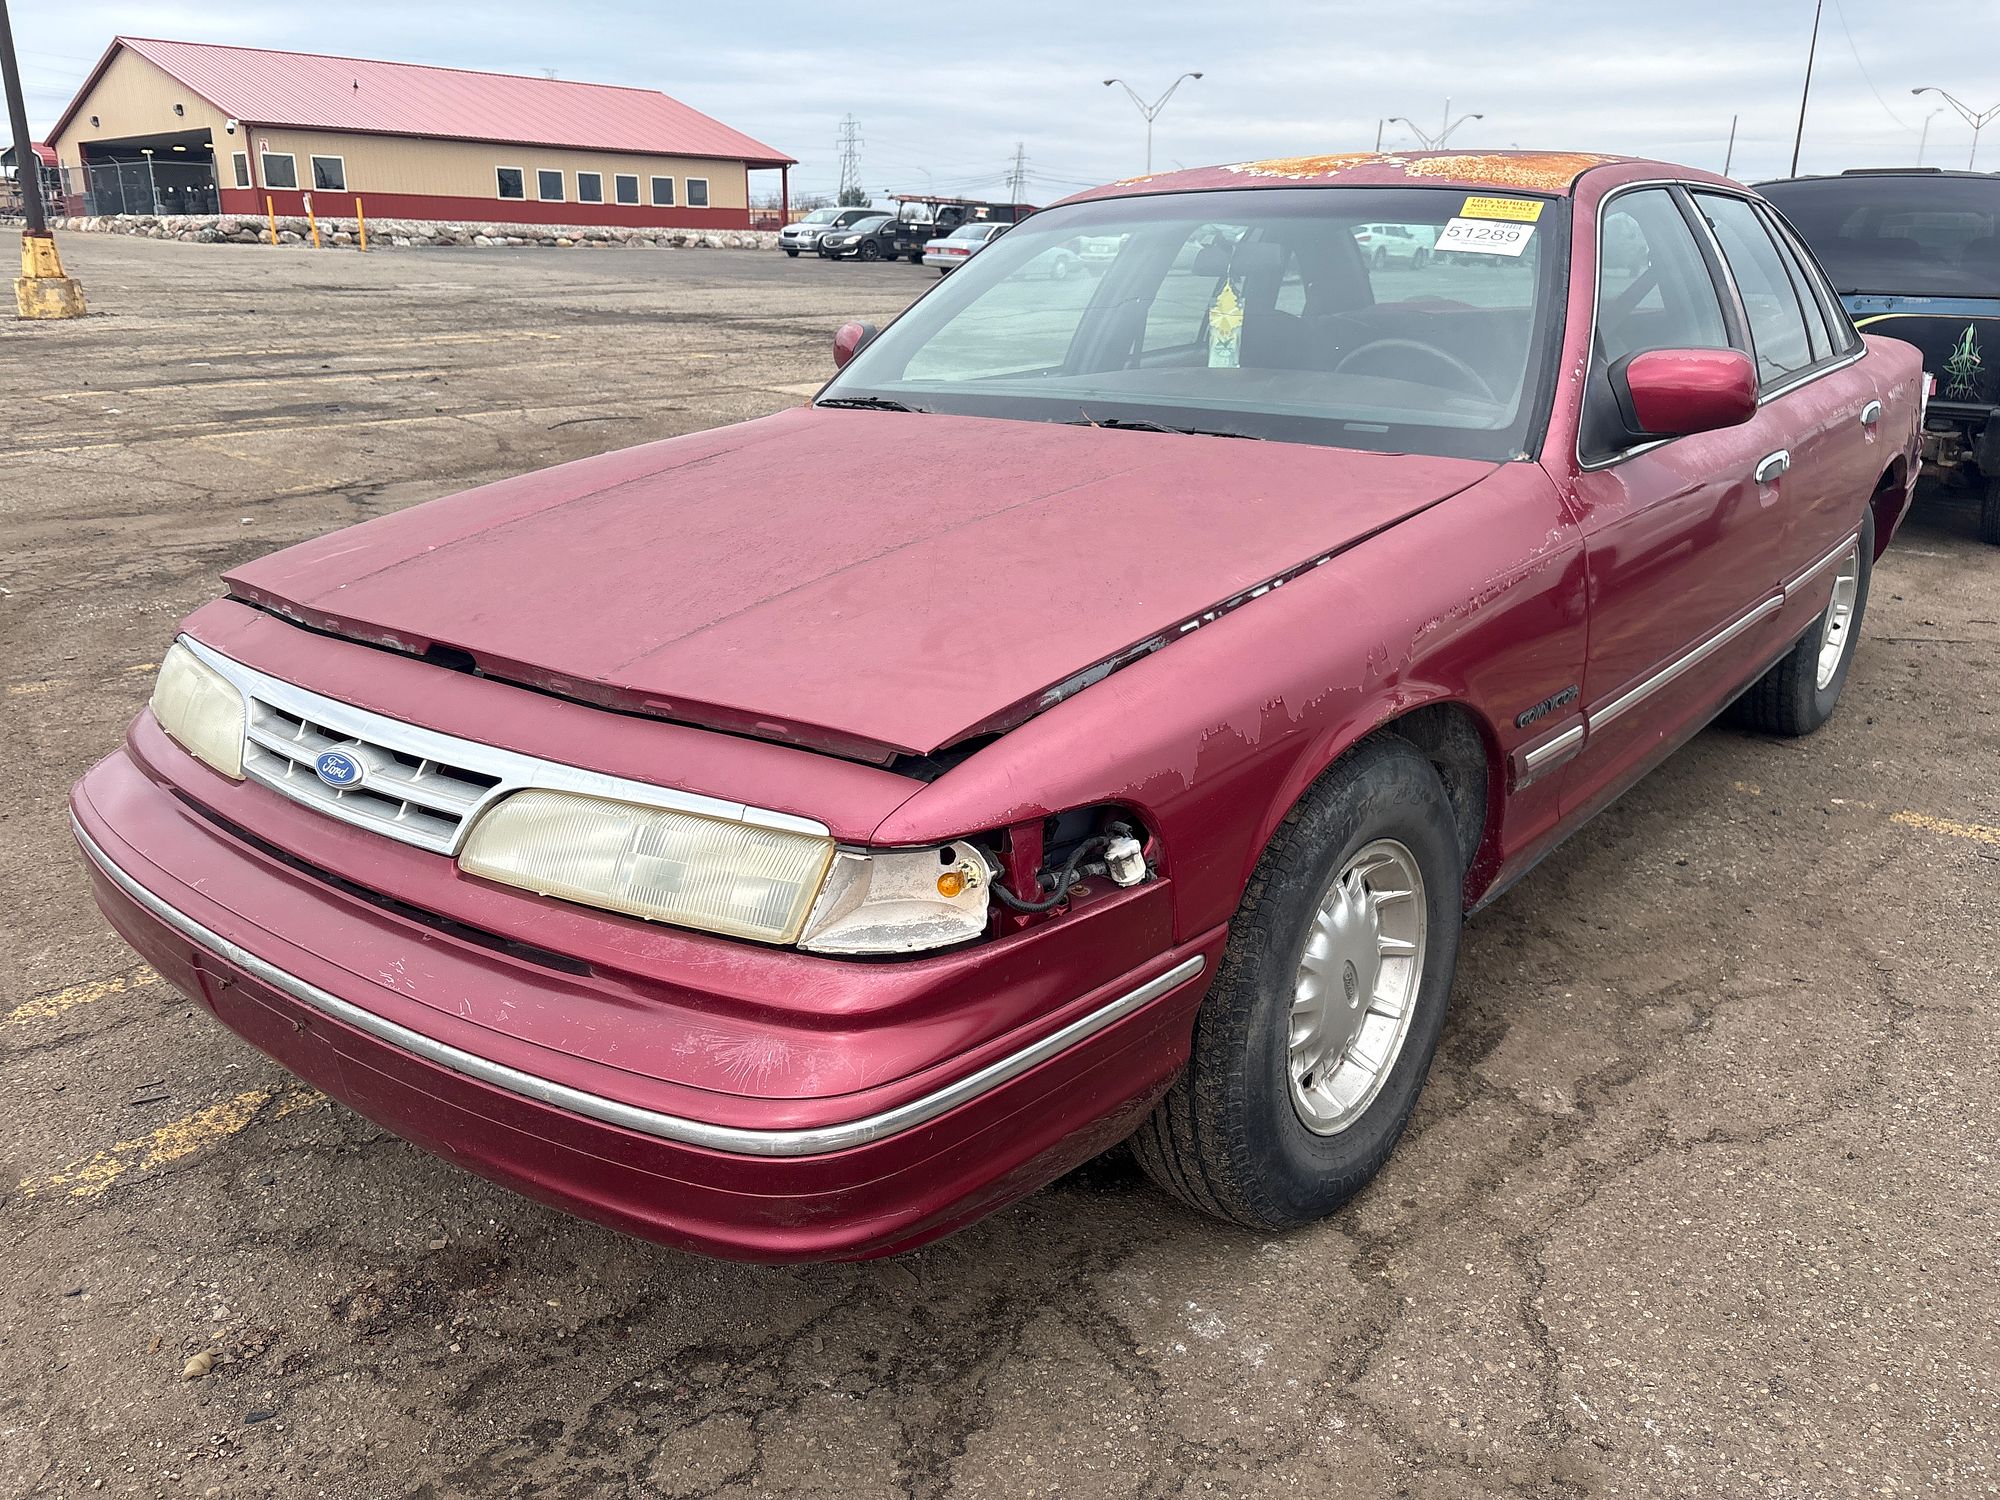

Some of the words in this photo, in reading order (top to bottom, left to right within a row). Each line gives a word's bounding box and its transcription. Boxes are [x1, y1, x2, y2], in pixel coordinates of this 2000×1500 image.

[262, 142, 268, 151] A
[1496, 200, 1538, 208] VEHICLE
[1446, 226, 1520, 242] 51289
[322, 755, 350, 779] Ford
